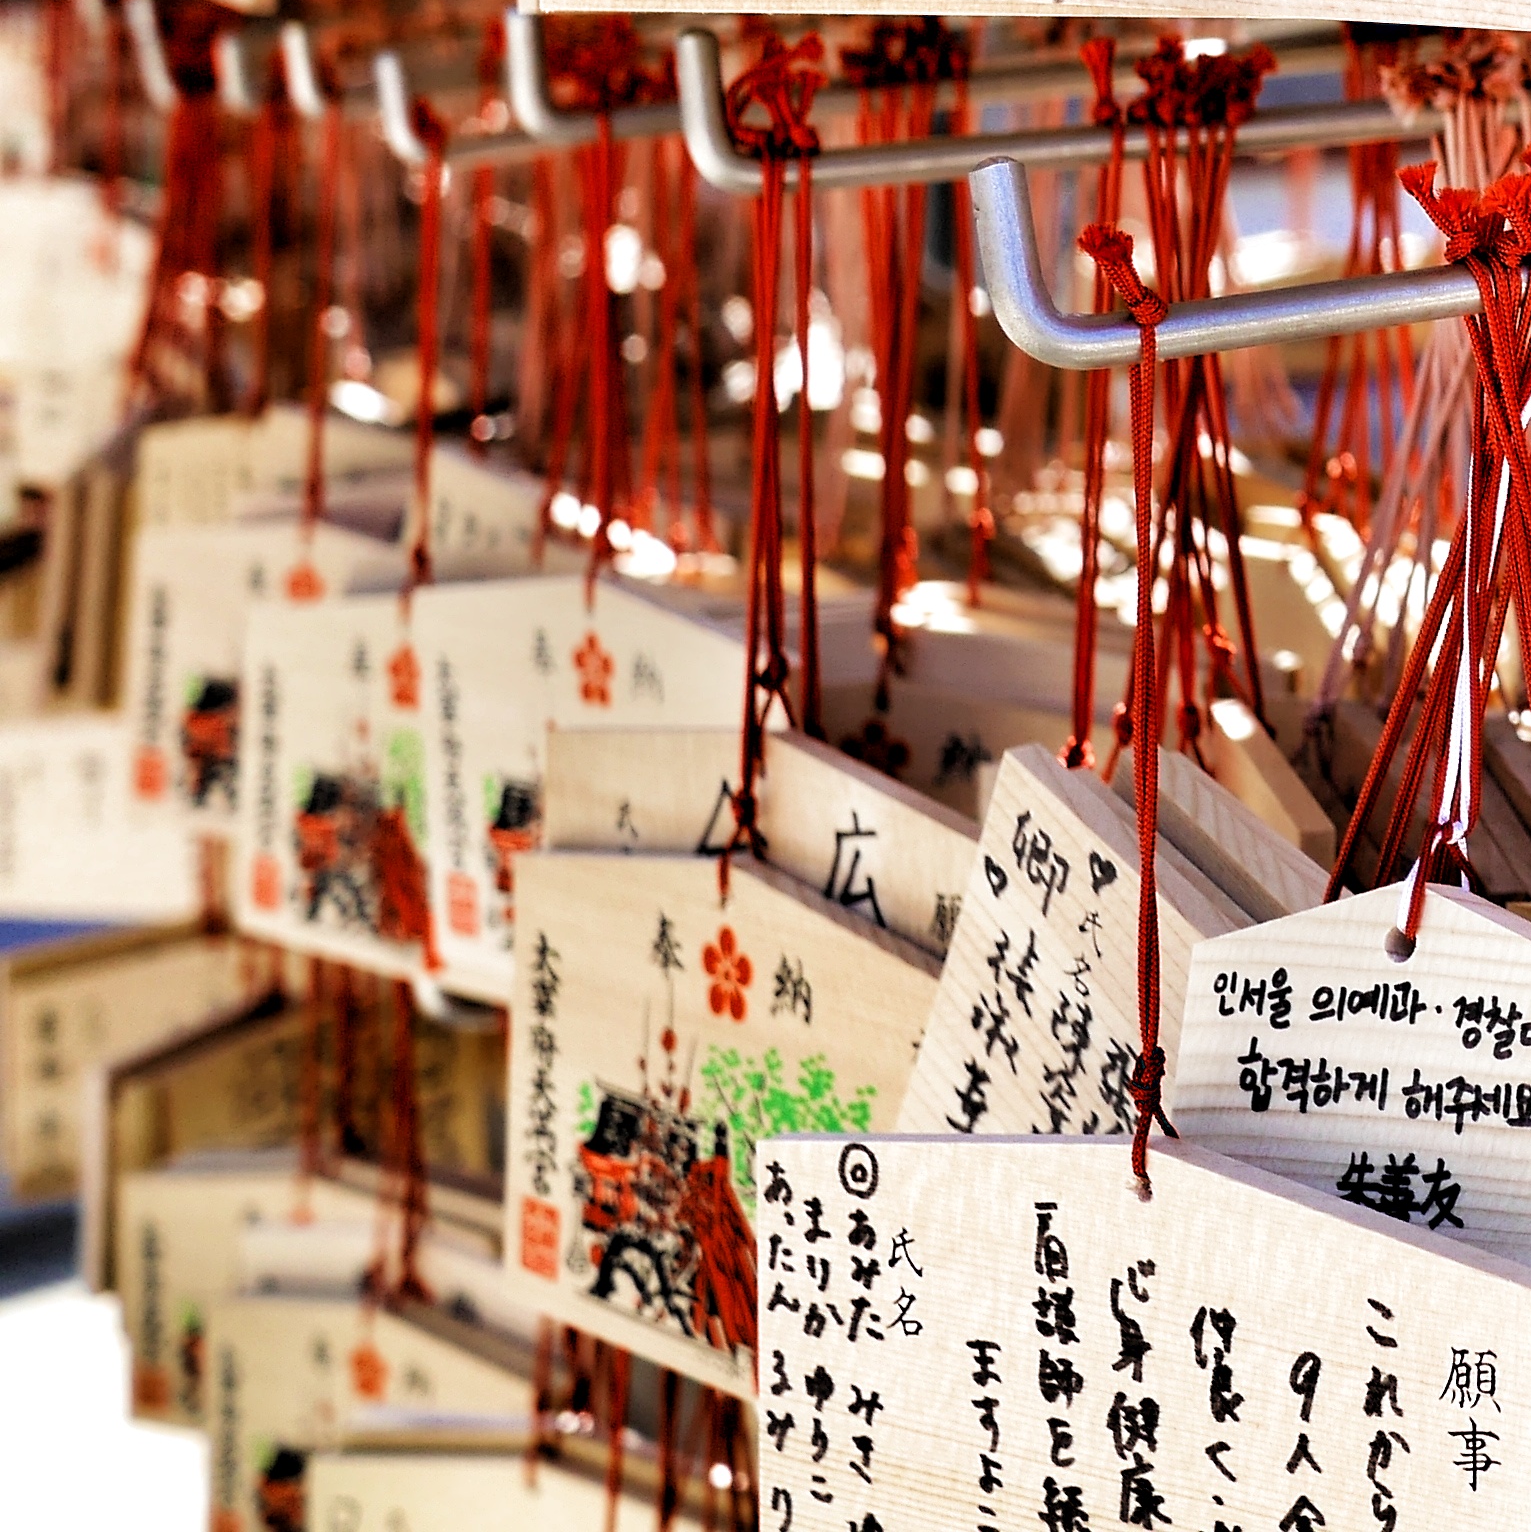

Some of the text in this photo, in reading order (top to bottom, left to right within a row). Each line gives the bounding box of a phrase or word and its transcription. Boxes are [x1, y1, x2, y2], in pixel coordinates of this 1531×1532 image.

[1213, 967, 1294, 1030] 인서울
[1237, 1036, 1391, 1114] 합격하게
[886, 1226, 924, 1337] 氏名
[1439, 1345, 1502, 1492] 願事
